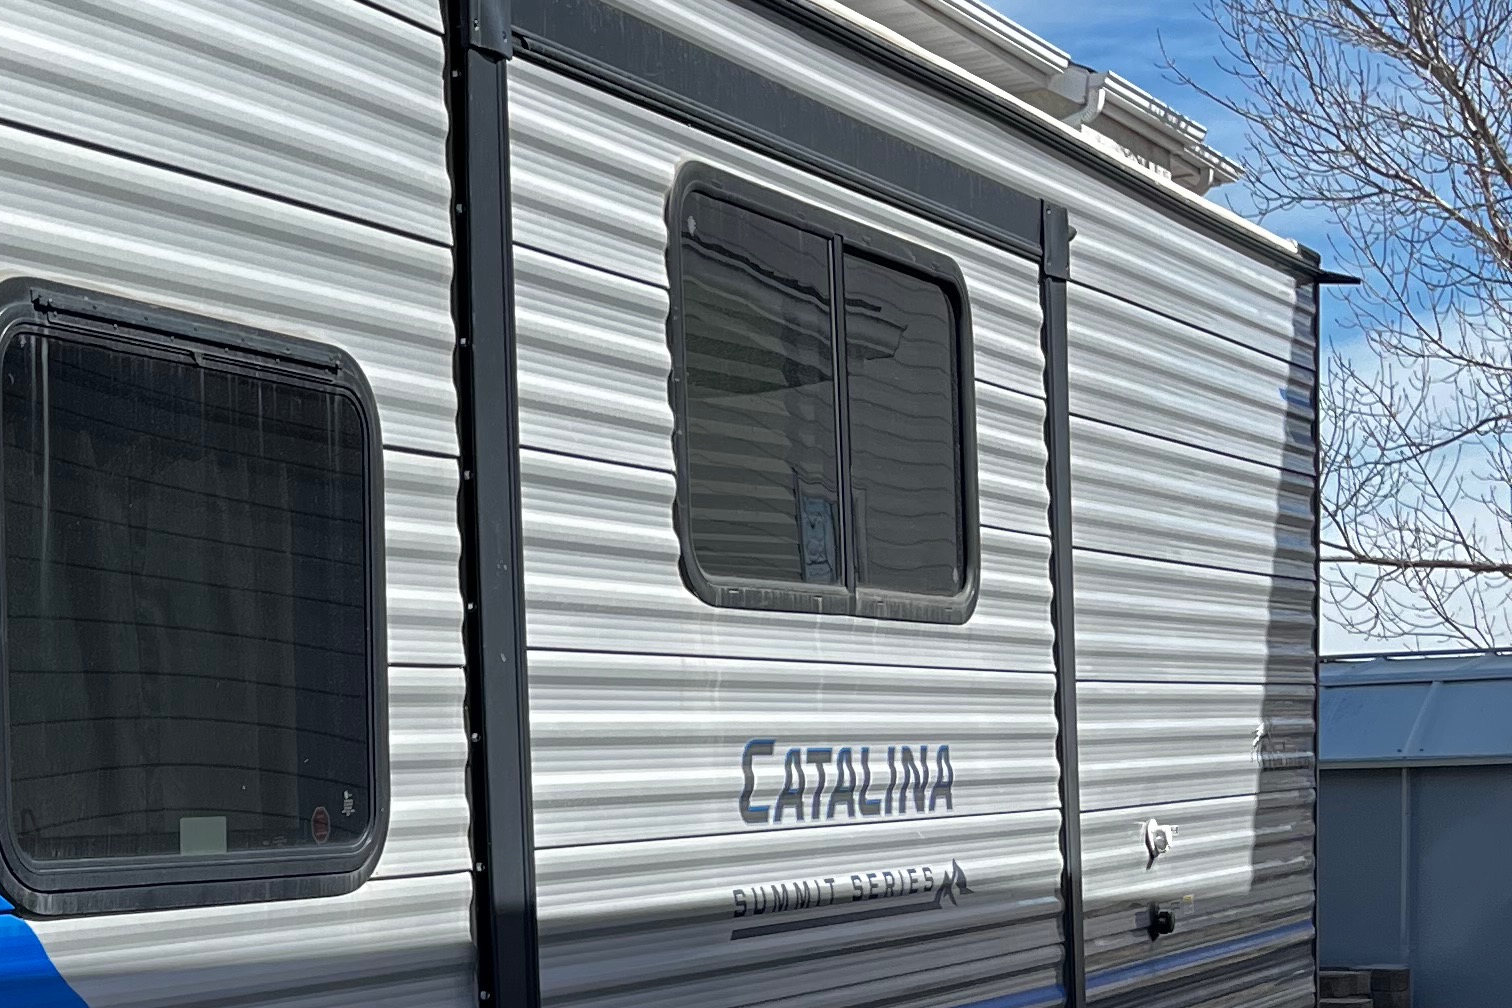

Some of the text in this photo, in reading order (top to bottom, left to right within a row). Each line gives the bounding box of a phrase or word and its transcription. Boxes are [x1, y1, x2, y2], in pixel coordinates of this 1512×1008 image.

[738, 737, 955, 825] CATALINA
[732, 866, 935, 918] SUMMIT SERIES
